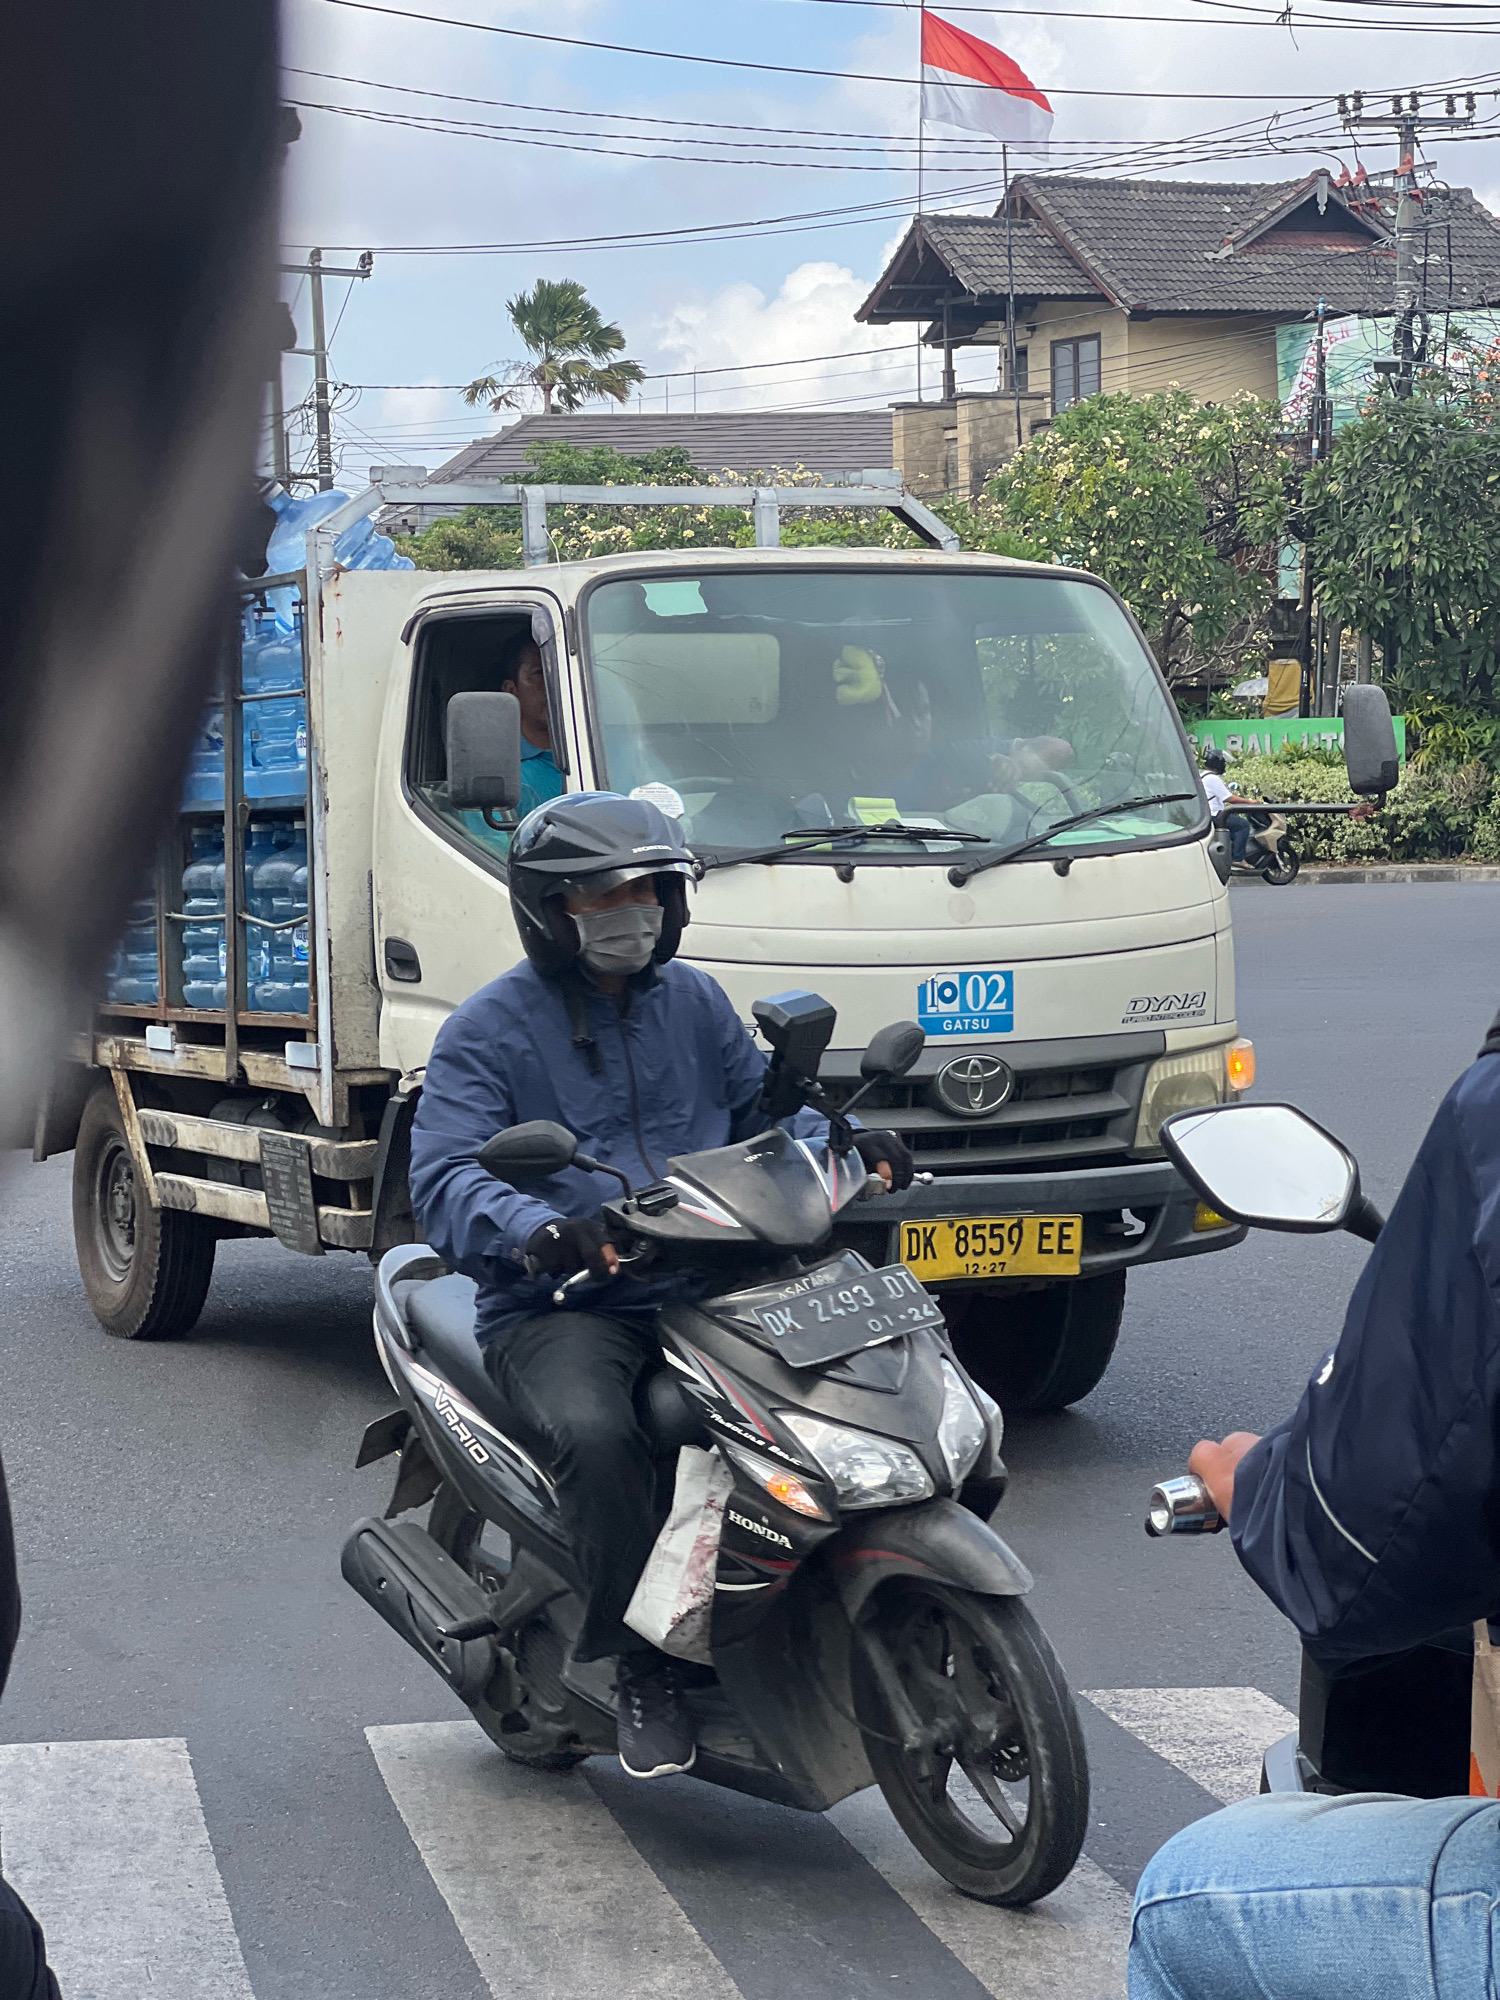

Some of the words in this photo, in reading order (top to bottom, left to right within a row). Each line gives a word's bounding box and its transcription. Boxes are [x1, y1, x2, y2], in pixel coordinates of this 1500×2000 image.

[965, 974, 1007, 1012] 02
[1125, 991, 1206, 1015] DYNA
[942, 1018, 990, 1031] GATSU
[906, 1226, 938, 1262] DK
[954, 1222, 1024, 1258] 8559
[1037, 1221, 1075, 1255] EE
[762, 1307, 806, 1337] DK
[808, 1284, 875, 1323] 2493
[881, 1271, 918, 1301] DT
[435, 1383, 491, 1466] VARIO
[728, 1509, 794, 1550] HONDA
